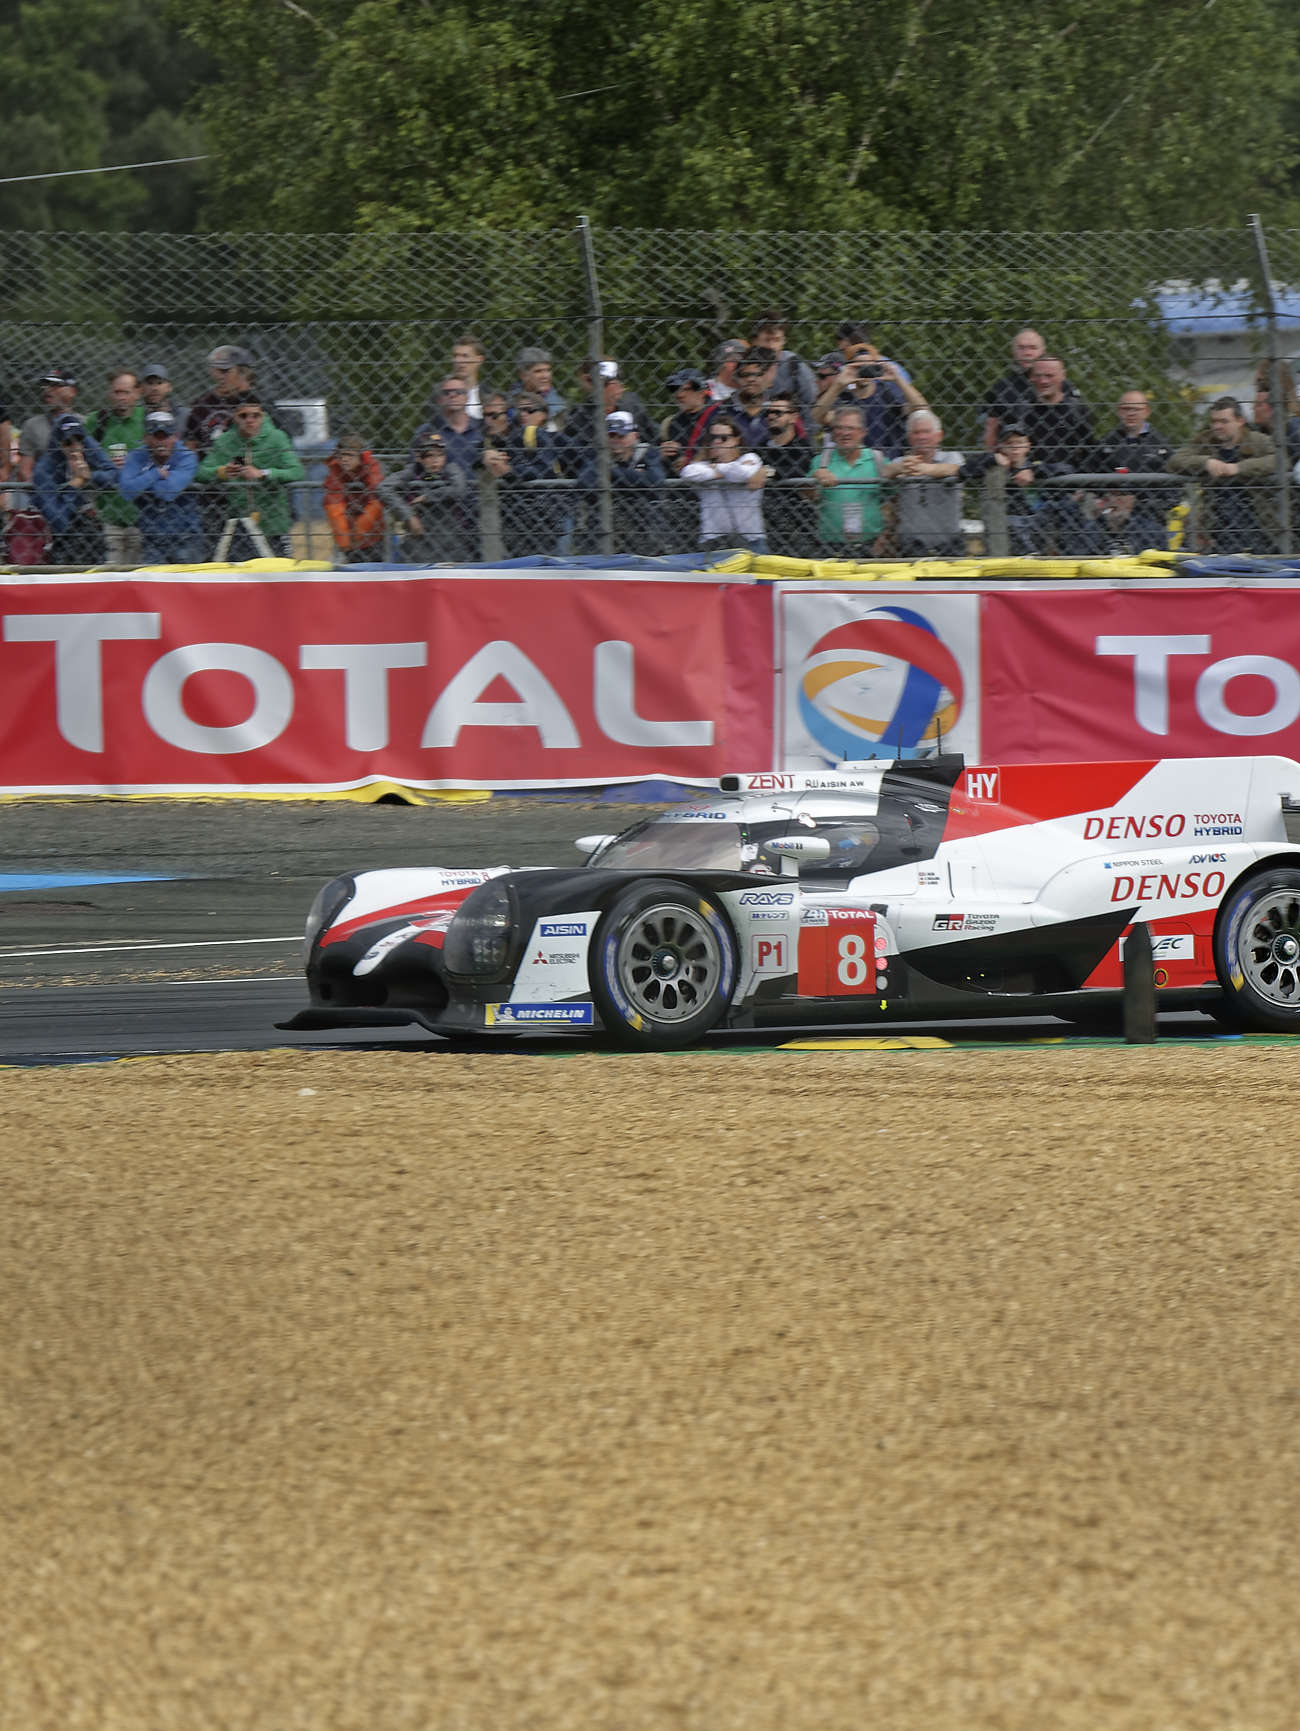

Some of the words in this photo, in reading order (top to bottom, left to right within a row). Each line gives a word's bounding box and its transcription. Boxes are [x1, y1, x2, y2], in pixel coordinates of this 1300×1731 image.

[2, 612, 715, 754] TOTAL
[747, 774, 795, 790] ZENT
[967, 773, 998, 799] HY
[1193, 814, 1242, 825] TOYOTA
[1083, 814, 1187, 840] DENSO
[1193, 827, 1243, 837] HYBRID
[1112, 860, 1140, 868] NIPPON
[1111, 871, 1226, 902] DENSO
[739, 893, 794, 905] RAYS
[828, 909, 875, 920] TOTAL
[544, 925, 584, 935] AISIN
[933, 920, 963, 931] GR
[757, 941, 783, 967] P1
[837, 934, 867, 986] 8
[516, 1009, 585, 1019] MICHELIN
